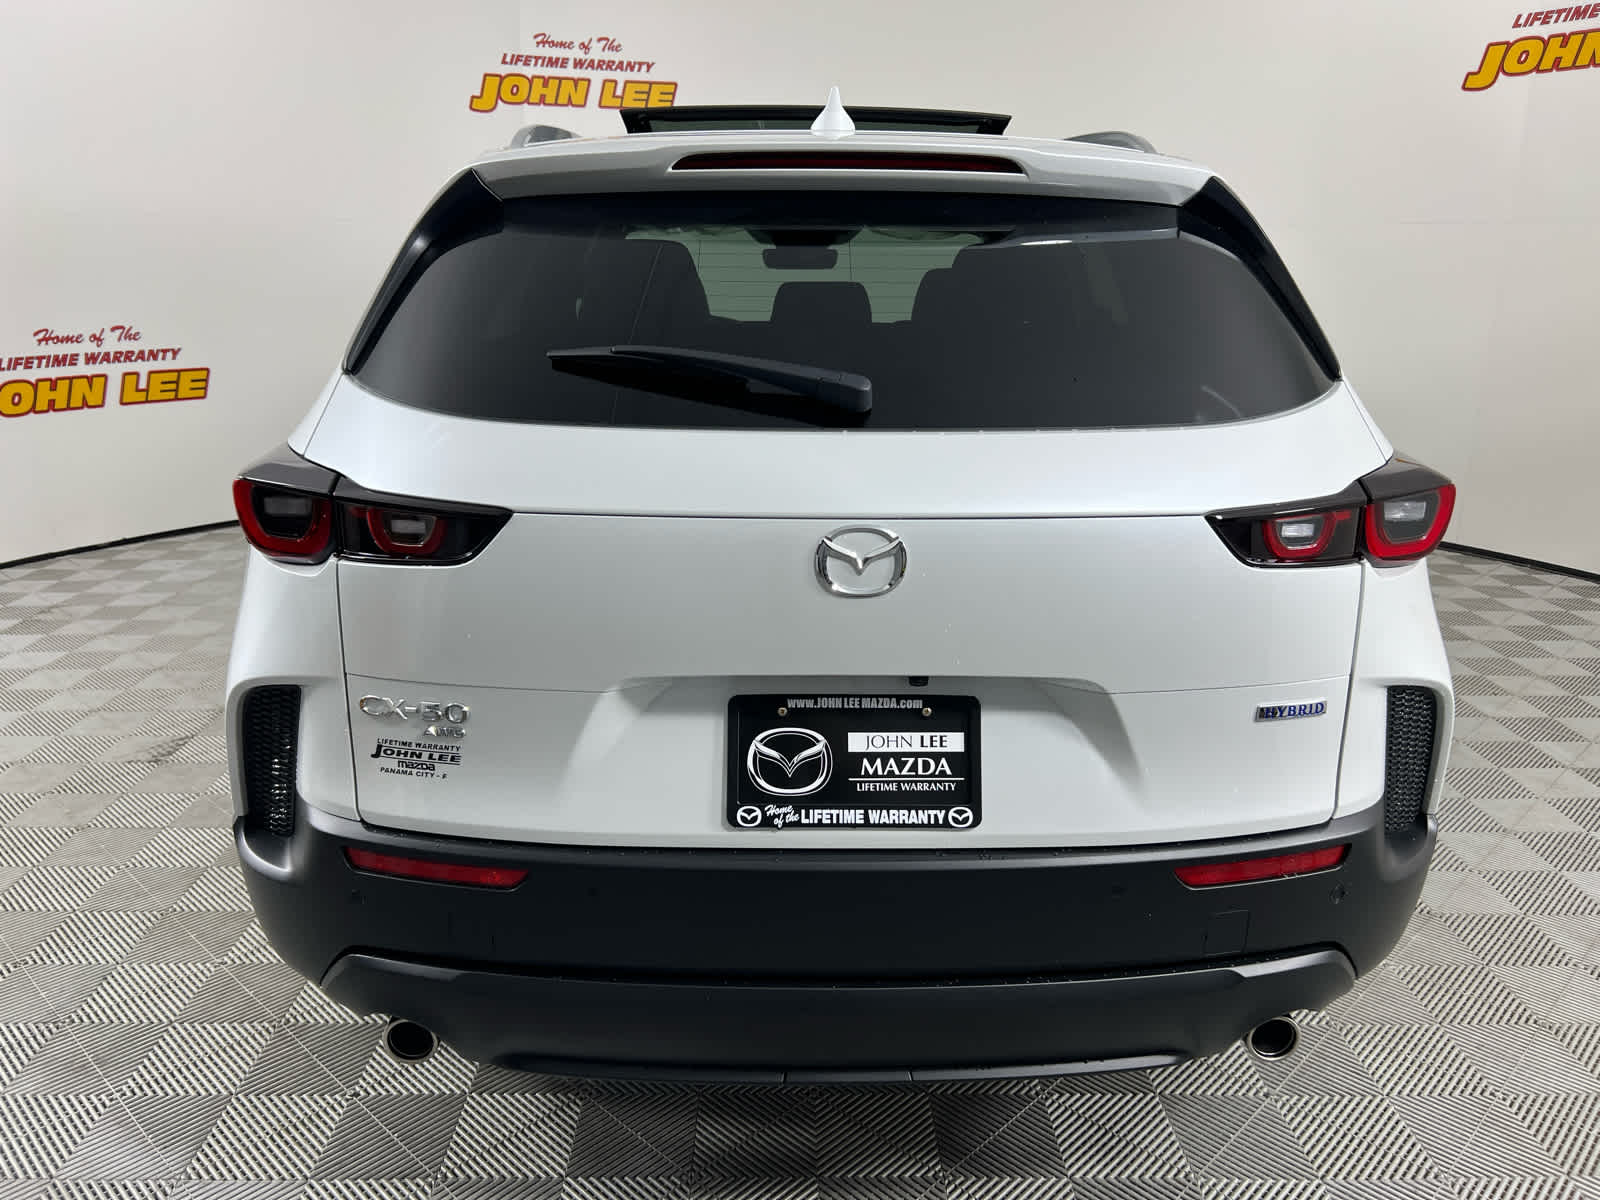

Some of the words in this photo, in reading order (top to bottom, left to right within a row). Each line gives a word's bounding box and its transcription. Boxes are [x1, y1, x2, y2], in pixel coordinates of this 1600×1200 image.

[1512, 3, 1600, 29] LIFETIME
[533, 32, 575, 51] Home
[578, 37, 593, 55] of
[596, 36, 623, 53] The
[500, 53, 570, 69] LIFETIME
[572, 57, 655, 73] WARRANTY
[469, 73, 591, 113] JOHN
[599, 78, 678, 110] LEE
[33, 327, 84, 346] Home
[88, 328, 105, 348] of
[110, 325, 142, 343] The
[84, 347, 182, 366] WARRANTY
[0, 374, 108, 417] OHN
[119, 367, 210, 405] LEE
[360, 694, 470, 724] CX-50
[844, 698, 861, 708] LEE
[1263, 702, 1325, 719] HYBRID
[377, 738, 413, 748] LIFETIME
[414, 742, 461, 752] WARRANTY
[865, 734, 913, 750] JOHN
[919, 734, 949, 749] LEE
[370, 744, 423, 759] JOHN
[427, 753, 461, 763] LEE
[380, 766, 413, 777] PANAMA
[415, 771, 435, 779] CITY
[860, 757, 952, 776] MAZDA
[856, 782, 899, 792] LIFETIME
[900, 782, 956, 792] WARRANTY
[764, 804, 794, 816] Home
[773, 816, 785, 829] of
[785, 810, 800, 823] the
[800, 808, 866, 825] LIFETIME
[868, 808, 947, 825] WARRANTY
